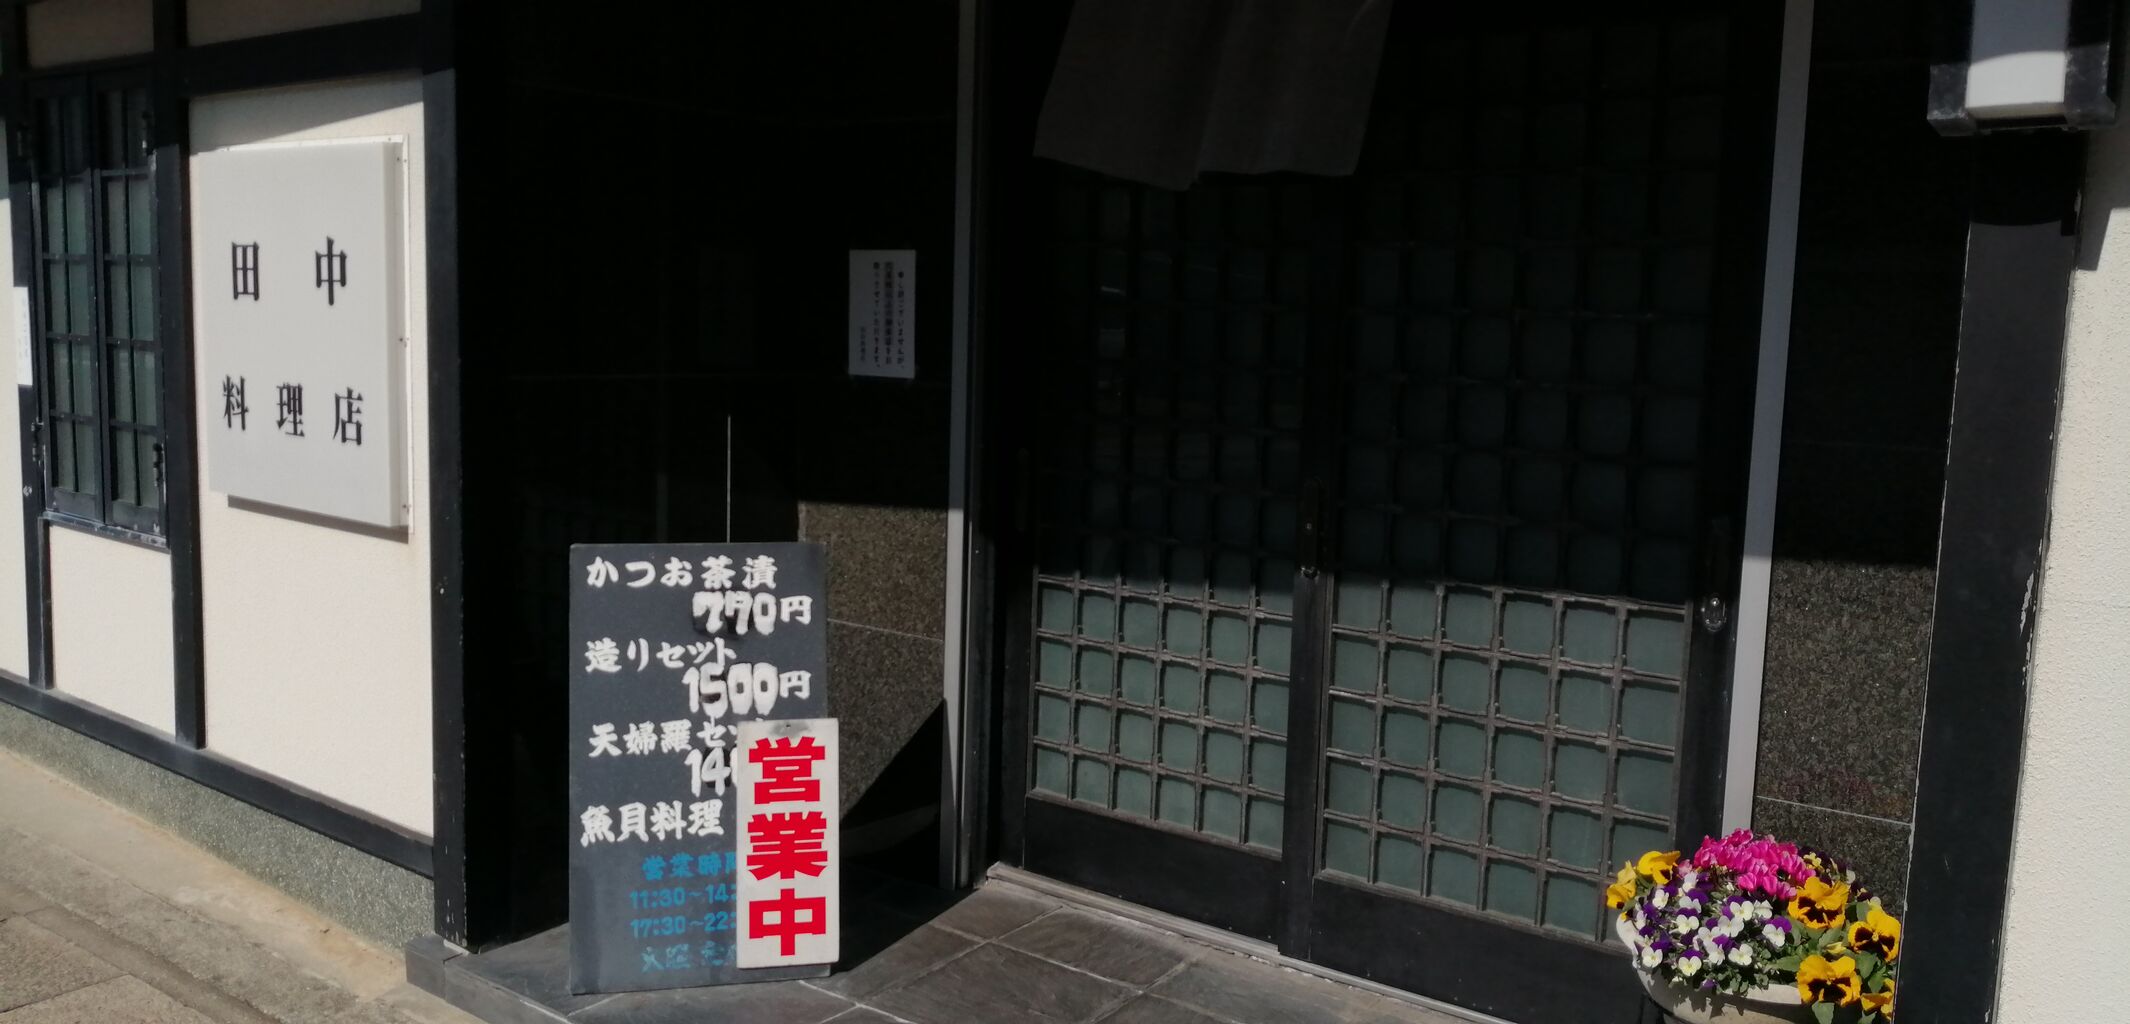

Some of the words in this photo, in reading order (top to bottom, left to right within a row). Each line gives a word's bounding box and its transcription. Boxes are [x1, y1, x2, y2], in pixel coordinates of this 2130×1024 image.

[231, 236, 347, 306] 田中
[223, 375, 363, 446] 料理店
[586, 555, 777, 589] かつお茶漬
[692, 590, 813, 635] 770円
[585, 636, 737, 674] 造りセット
[682, 662, 812, 719] 1500円
[588, 718, 738, 758] 天婦羅セ
[684, 748, 738, 798] 14
[580, 798, 725, 848] 魚貝料理
[745, 736, 828, 957] 営業中
